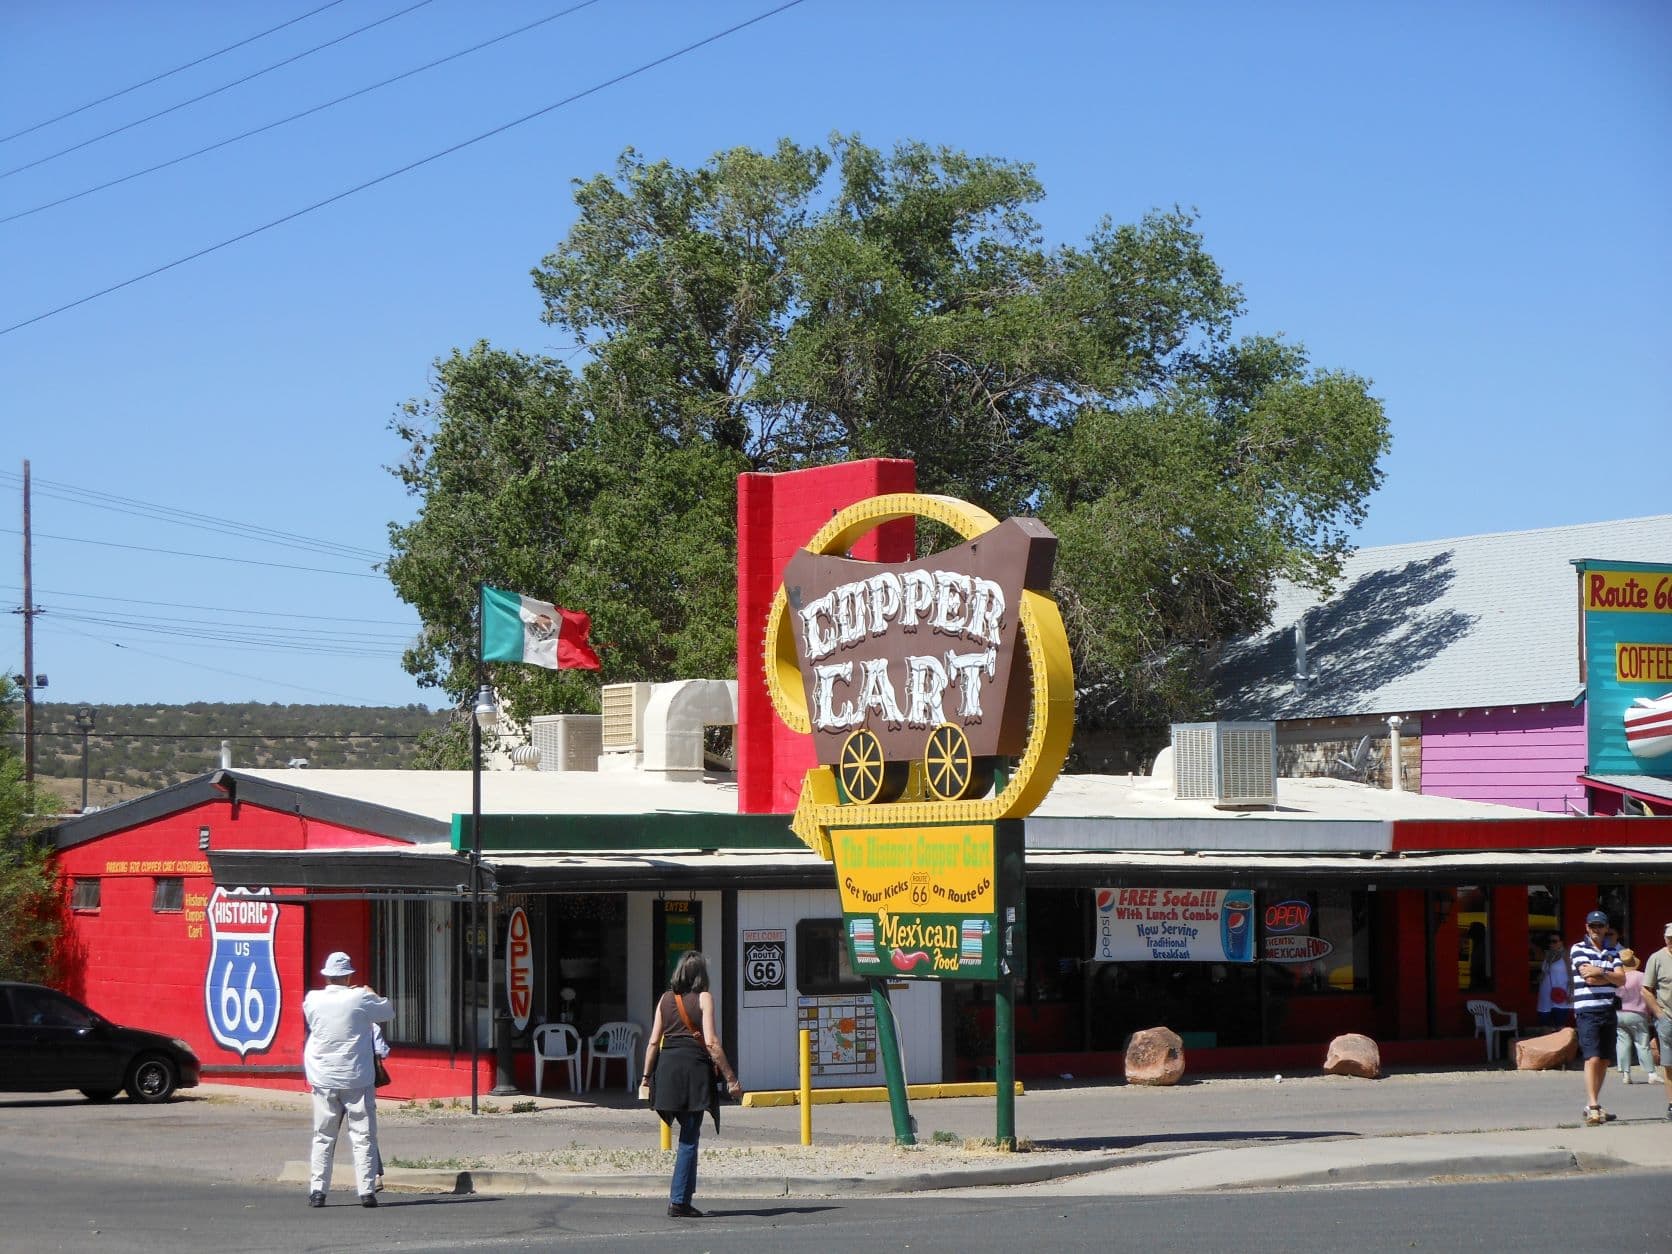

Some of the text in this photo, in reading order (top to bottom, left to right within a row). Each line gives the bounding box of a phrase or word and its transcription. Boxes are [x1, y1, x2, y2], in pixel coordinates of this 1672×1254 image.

[1590, 574, 1648, 609] Route
[799, 569, 1005, 660] COPPER
[1619, 646, 1672, 680] COFFEE
[812, 647, 996, 730] CART
[841, 836, 863, 868] The
[917, 835, 960, 875] Copper
[963, 834, 990, 868] Cart
[845, 877, 909, 903] Get Your Kicks
[912, 885, 928, 903] 66
[933, 878, 991, 903] on Route 66
[1119, 889, 1217, 907] FREE Soda!!!
[215, 902, 267, 924] HISTORIC
[664, 901, 689, 913] ENTER
[1116, 907, 1219, 920] With Lunch Combo
[1265, 906, 1308, 926] OPEN
[188, 924, 203, 938] Cart
[744, 931, 785, 941] WELCOME
[879, 911, 958, 948] Mexican
[1100, 916, 1113, 958] pepsi
[1136, 921, 1199, 940] Now Serving
[235, 942, 250, 957] US
[1145, 937, 1187, 948] Traditional
[1152, 948, 1191, 959] Breakfast
[510, 911, 530, 1019] OPEN
[933, 947, 960, 971] Food
[753, 962, 777, 980] 66
[221, 961, 265, 1033] 66
